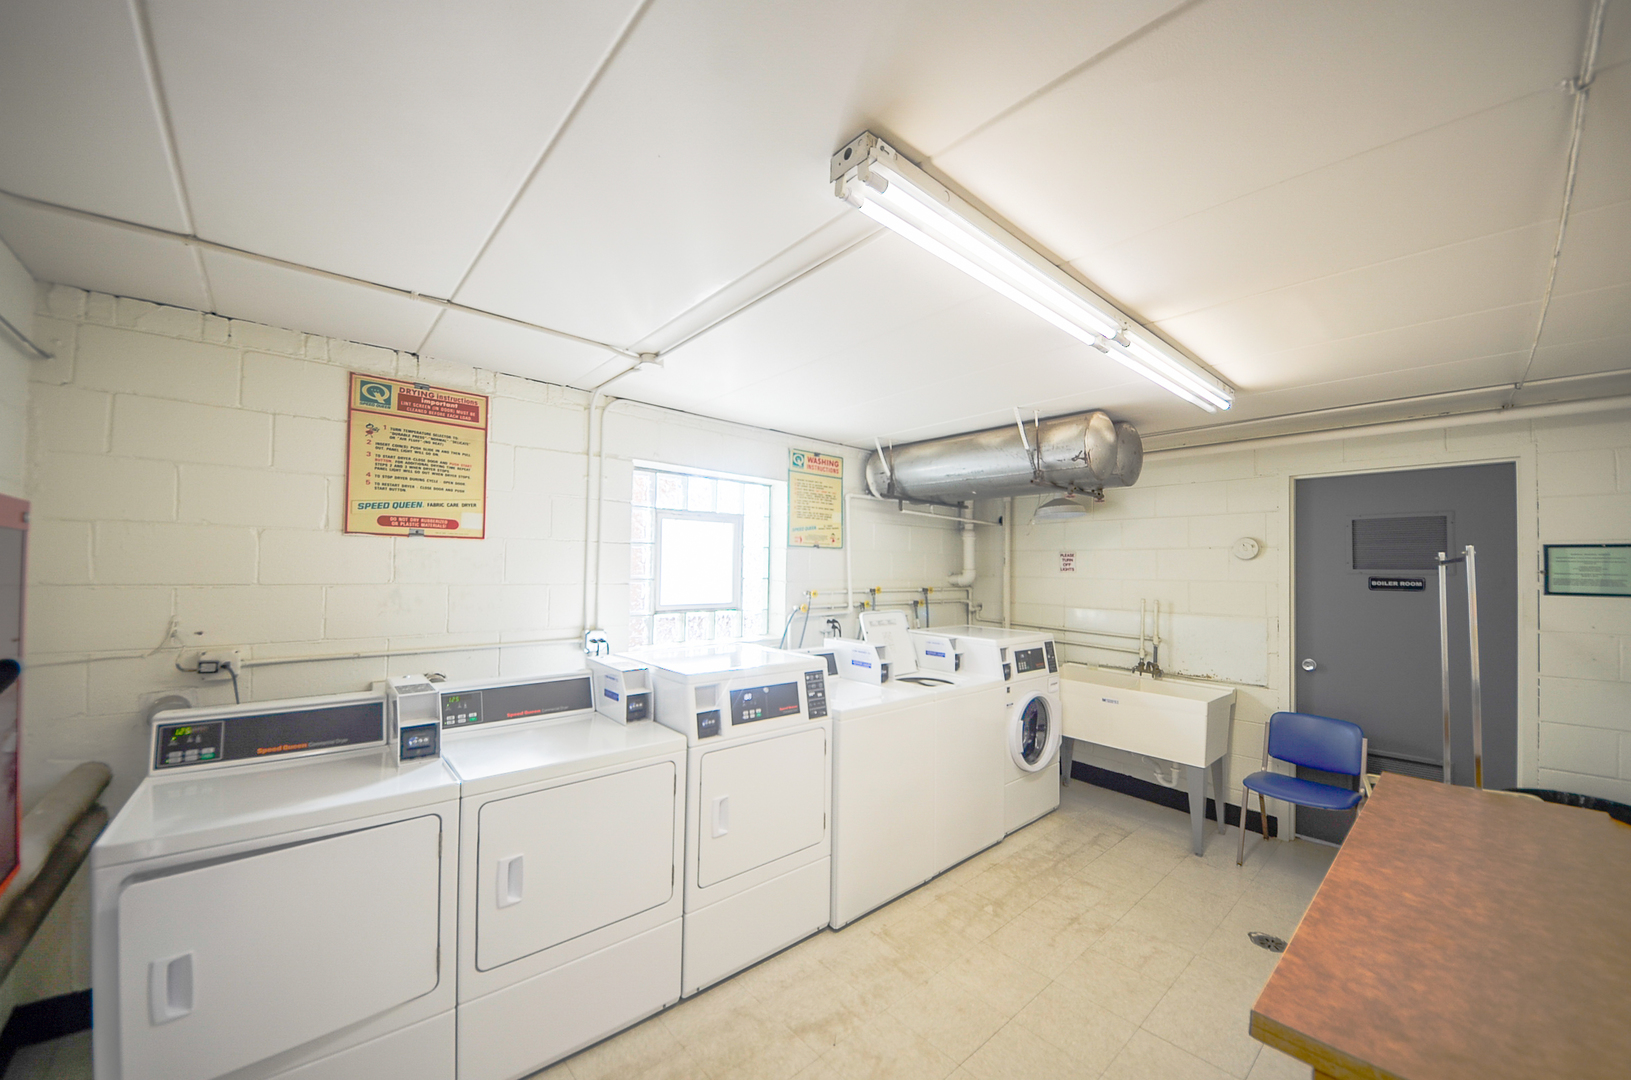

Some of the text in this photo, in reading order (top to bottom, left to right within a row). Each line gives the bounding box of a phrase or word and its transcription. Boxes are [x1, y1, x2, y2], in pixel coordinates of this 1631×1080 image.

[399, 387, 434, 398] DRYING
[413, 402, 431, 410] SCREEN
[807, 456, 839, 467] WASHING
[807, 464, 839, 474] INSTRUCTIONS
[358, 502, 390, 510] SPEED
[392, 501, 423, 509] QUEEN
[507, 710, 524, 718] Speed
[257, 745, 282, 755] Speed
[283, 742, 308, 751] Queen
